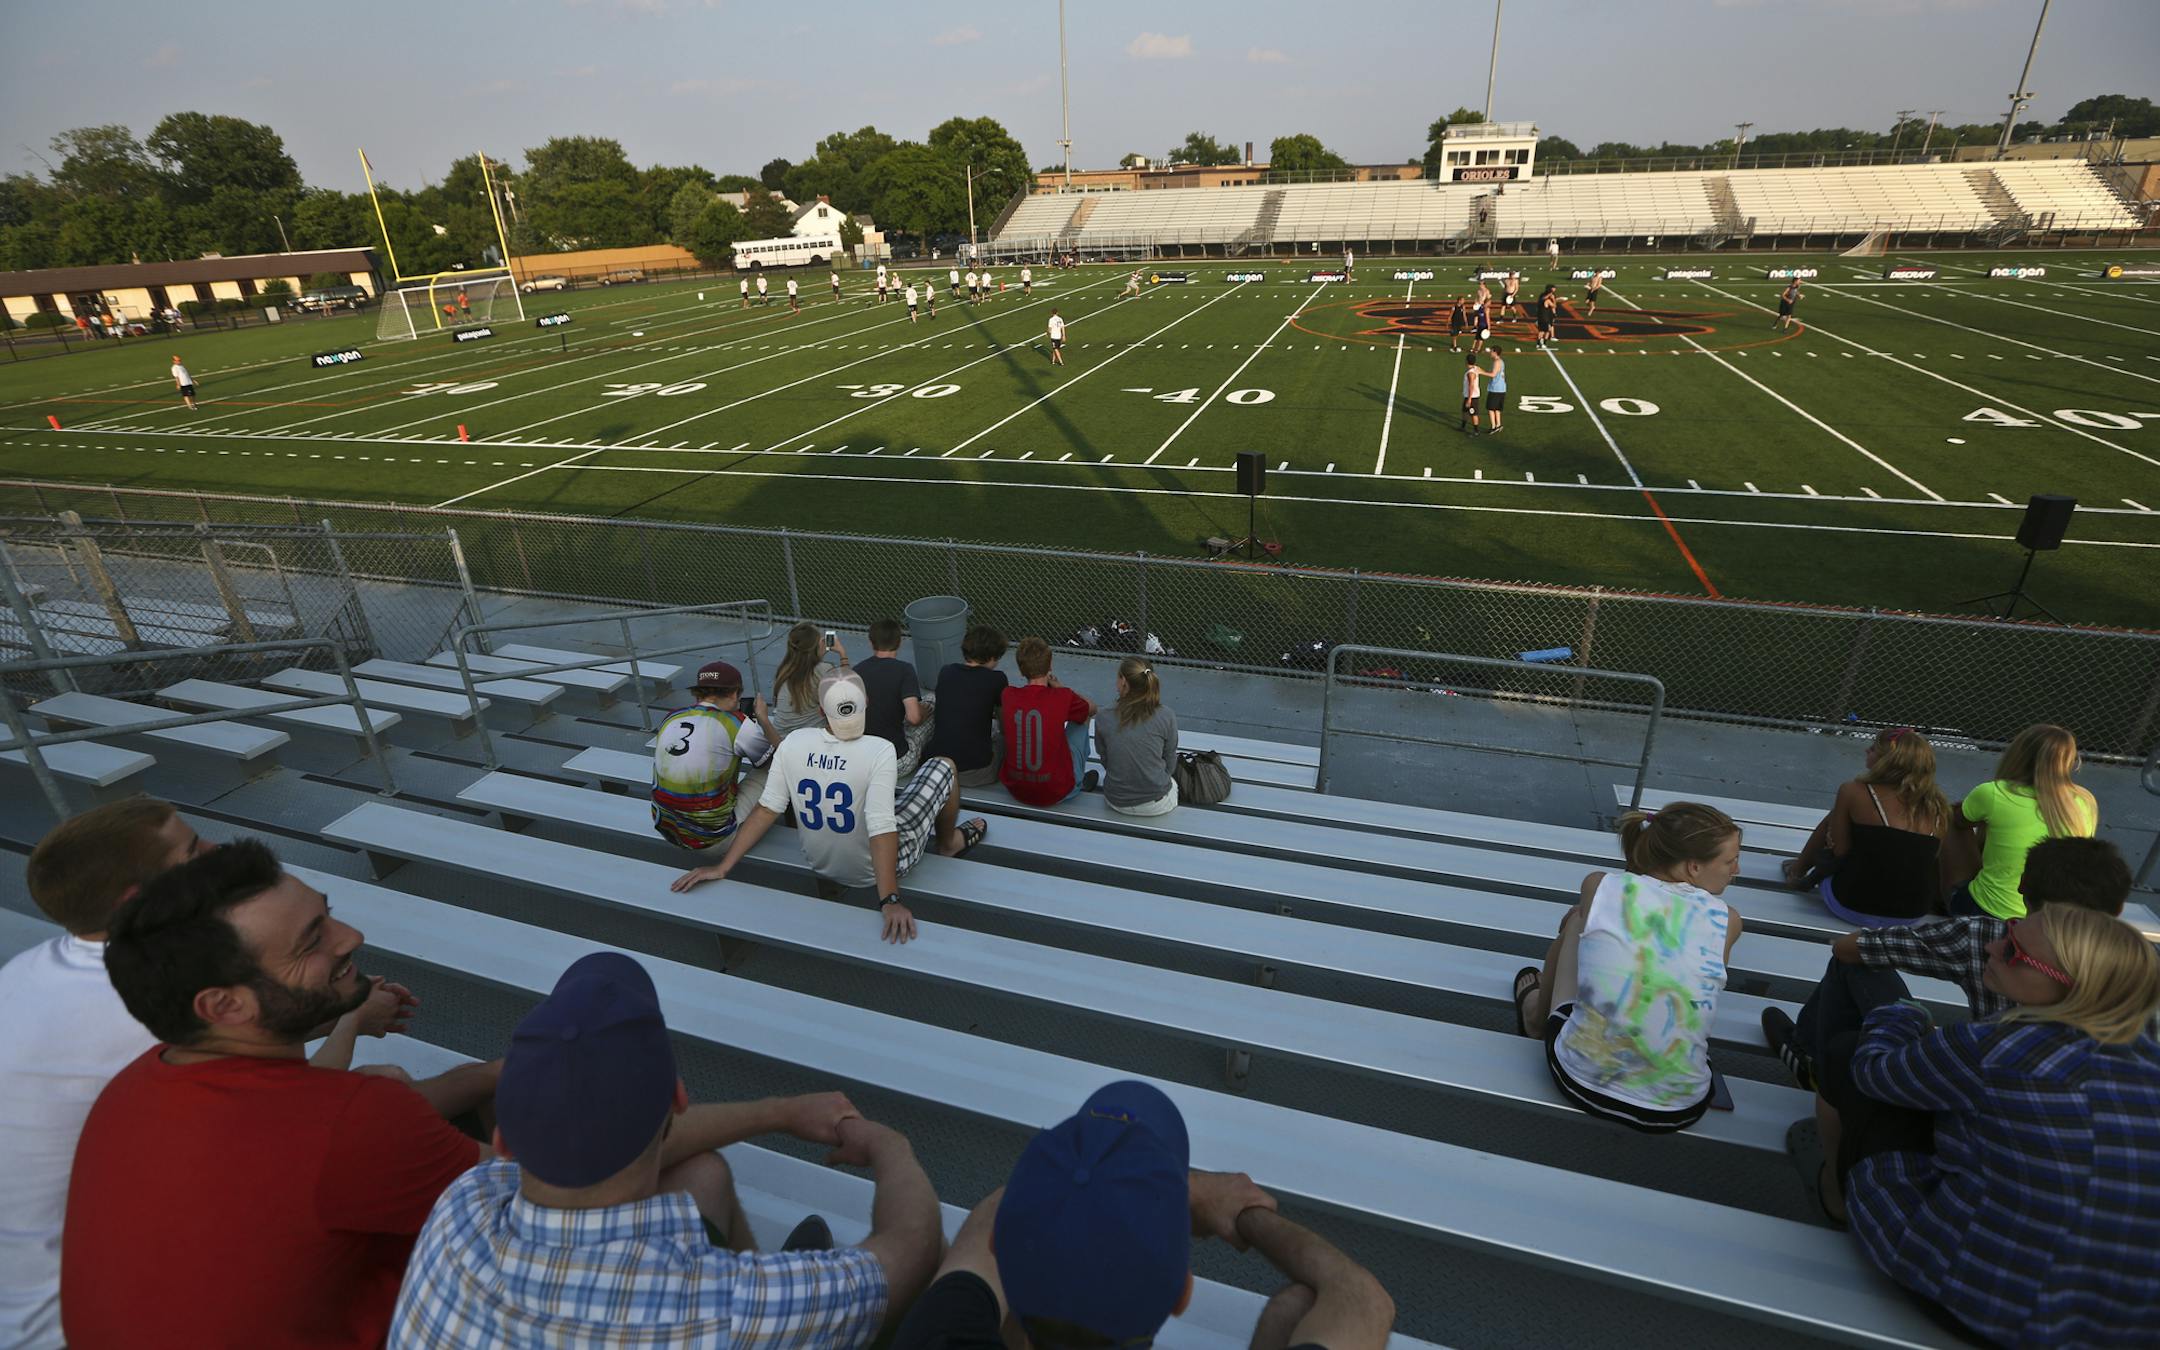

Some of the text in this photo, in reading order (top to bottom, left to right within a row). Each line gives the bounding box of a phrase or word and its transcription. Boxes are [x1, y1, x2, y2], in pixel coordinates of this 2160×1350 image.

[1461, 170, 1510, 180] ORIOLES
[1572, 270, 1616, 279] nexen
[1991, 268, 2046, 279] nexgen
[665, 722, 695, 756] 3
[1014, 709, 1042, 771] 10
[797, 778, 855, 834] 33
